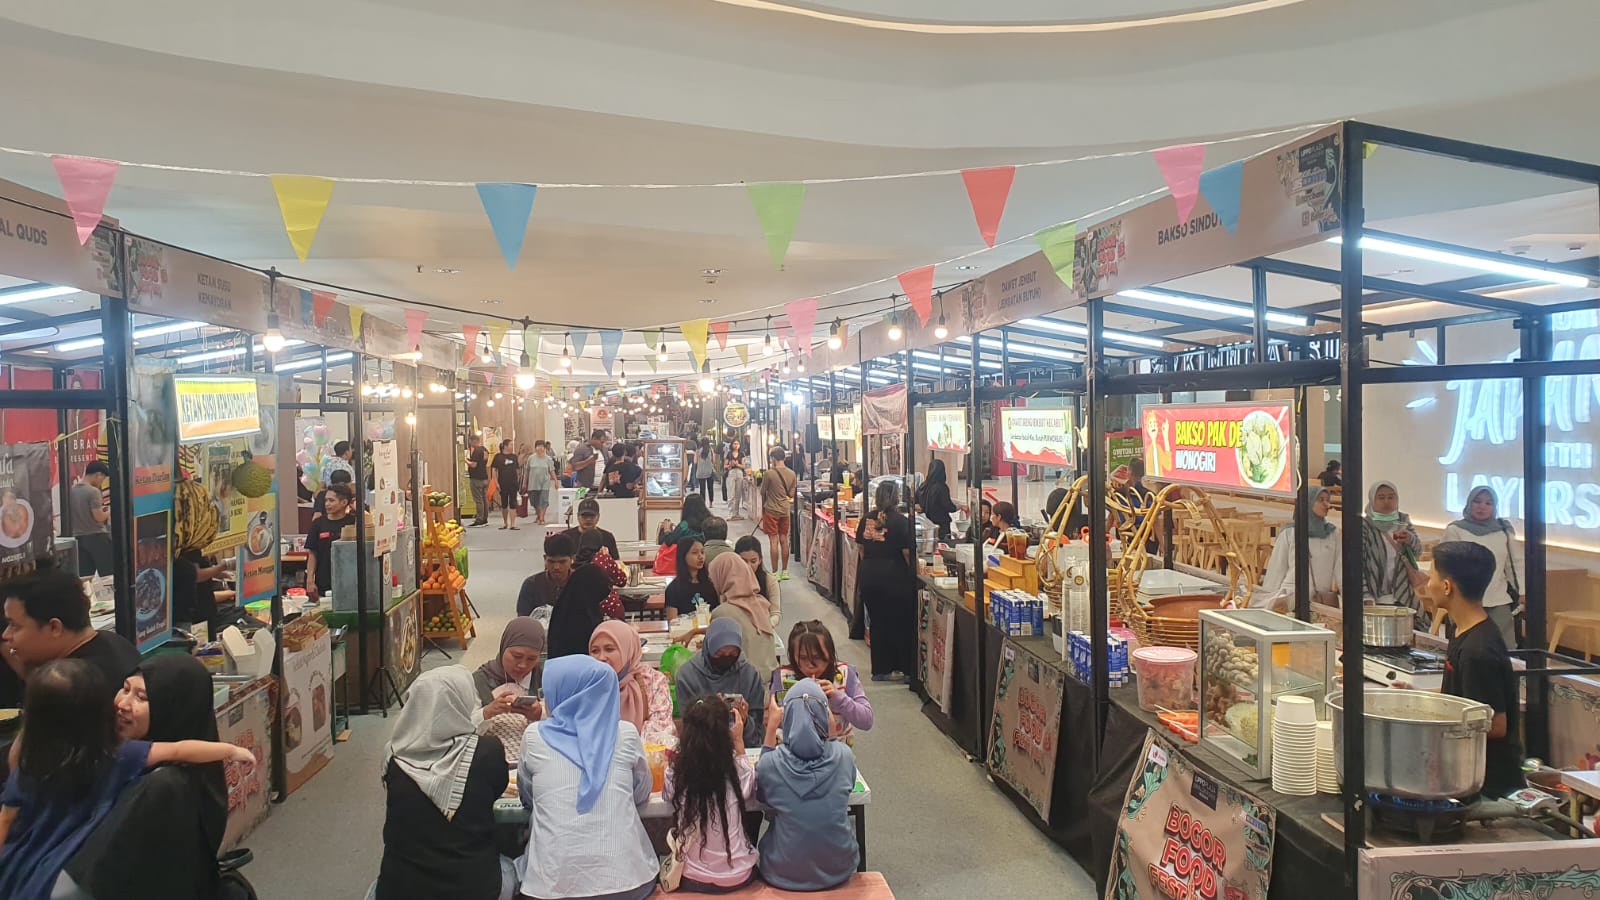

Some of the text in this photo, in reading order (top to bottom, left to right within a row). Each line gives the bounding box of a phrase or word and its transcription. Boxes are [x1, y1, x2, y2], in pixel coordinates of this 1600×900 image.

[17, 224, 48, 246] QUDS
[1157, 222, 1188, 246] BAKSO
[1175, 420, 1244, 448] BAKSO PAK DE
[1165, 803, 1226, 875] BOGOR
[1161, 838, 1218, 899] FOOD
